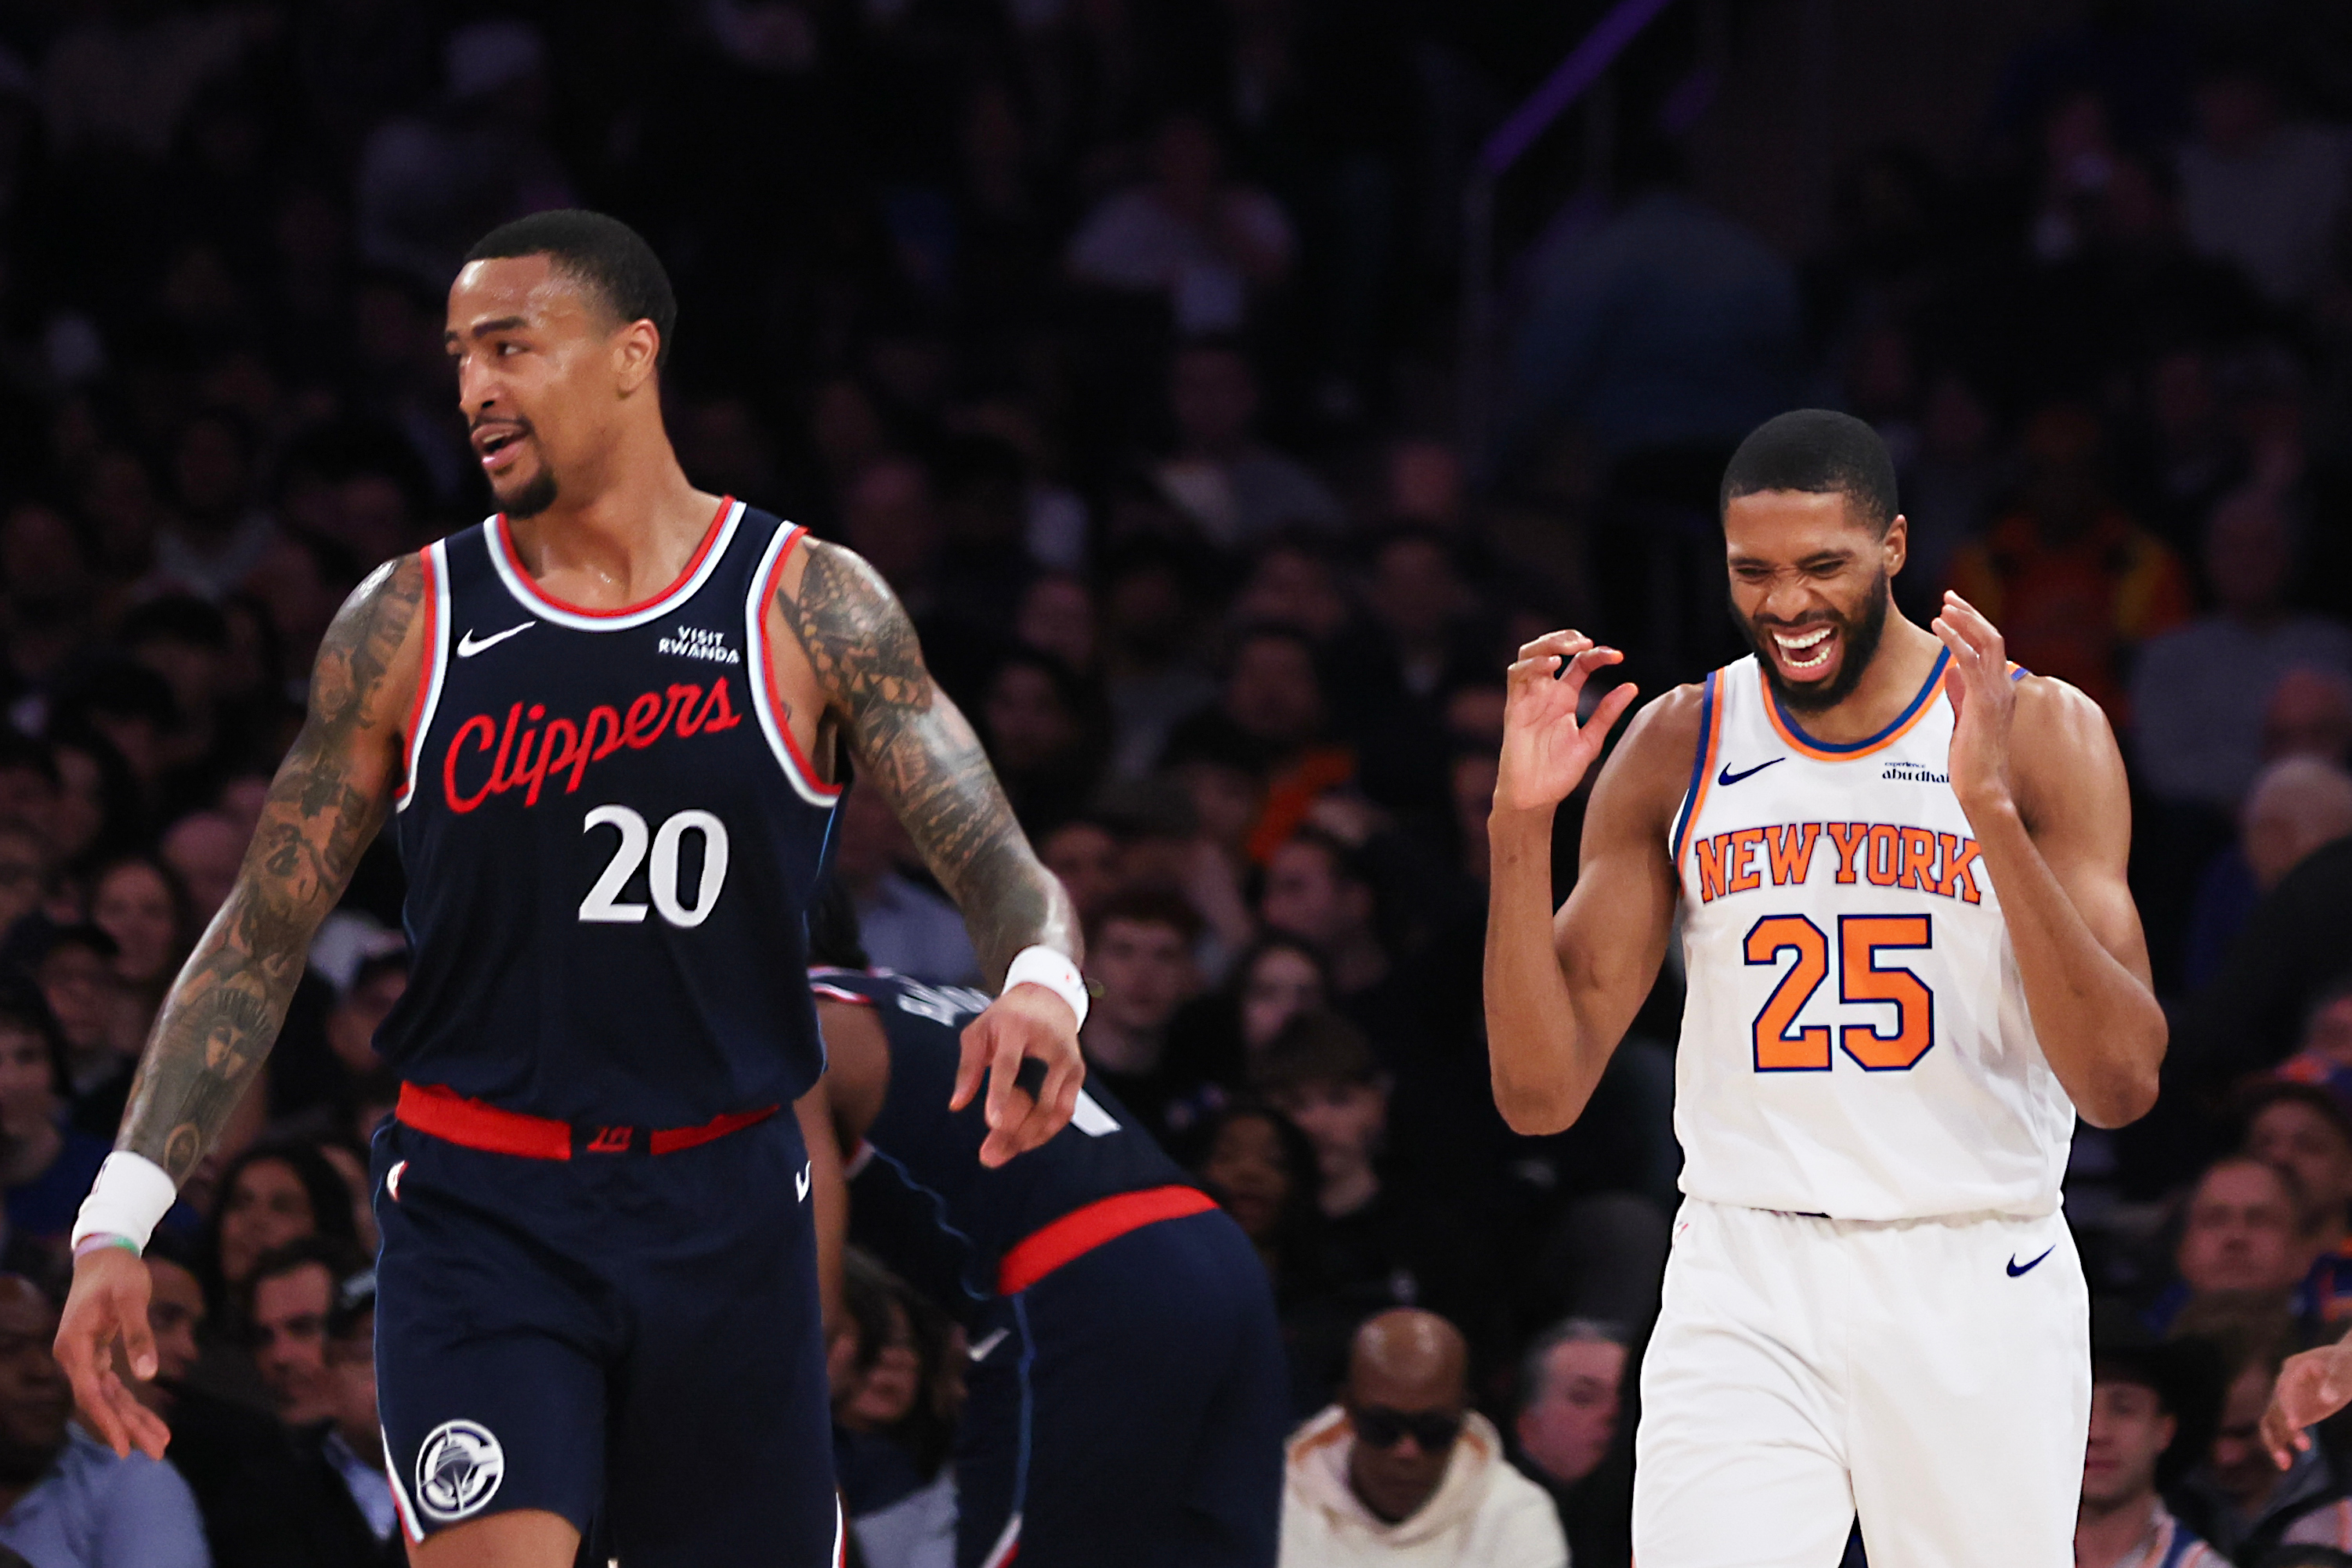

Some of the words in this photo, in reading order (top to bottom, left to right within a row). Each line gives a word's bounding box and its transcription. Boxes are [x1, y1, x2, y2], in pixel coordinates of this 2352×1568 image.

[659, 637, 740, 663] RWANDA
[677, 625, 724, 647] VISIT
[443, 676, 742, 814] Clippers
[579, 804, 729, 928] 20
[1696, 823, 1820, 904] NEW
[1827, 822, 1982, 905] YORK
[1743, 913, 1935, 1072] 25
